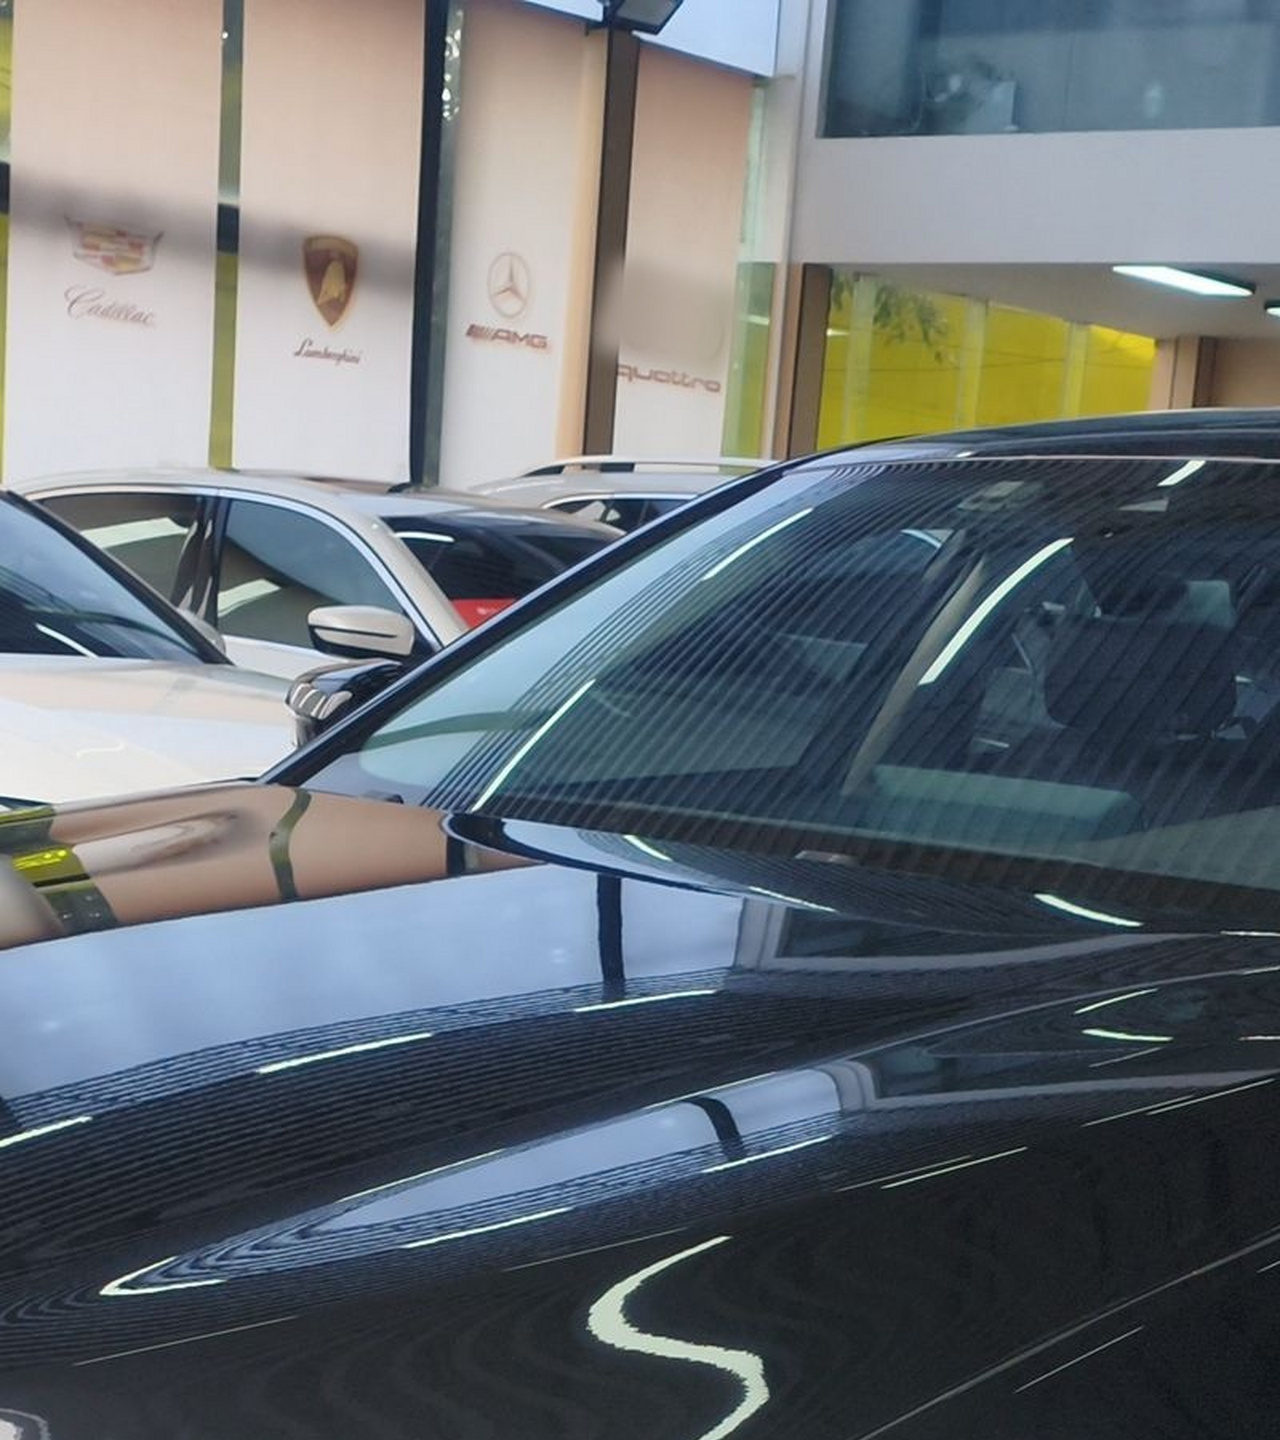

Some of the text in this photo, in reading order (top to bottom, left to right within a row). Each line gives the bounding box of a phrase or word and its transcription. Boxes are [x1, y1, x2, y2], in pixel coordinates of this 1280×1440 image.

[64, 284, 155, 328] Cadillac
[293, 337, 362, 366] Lamborghini
[490, 328, 549, 350] AMG
[617, 364, 722, 393] quattro
